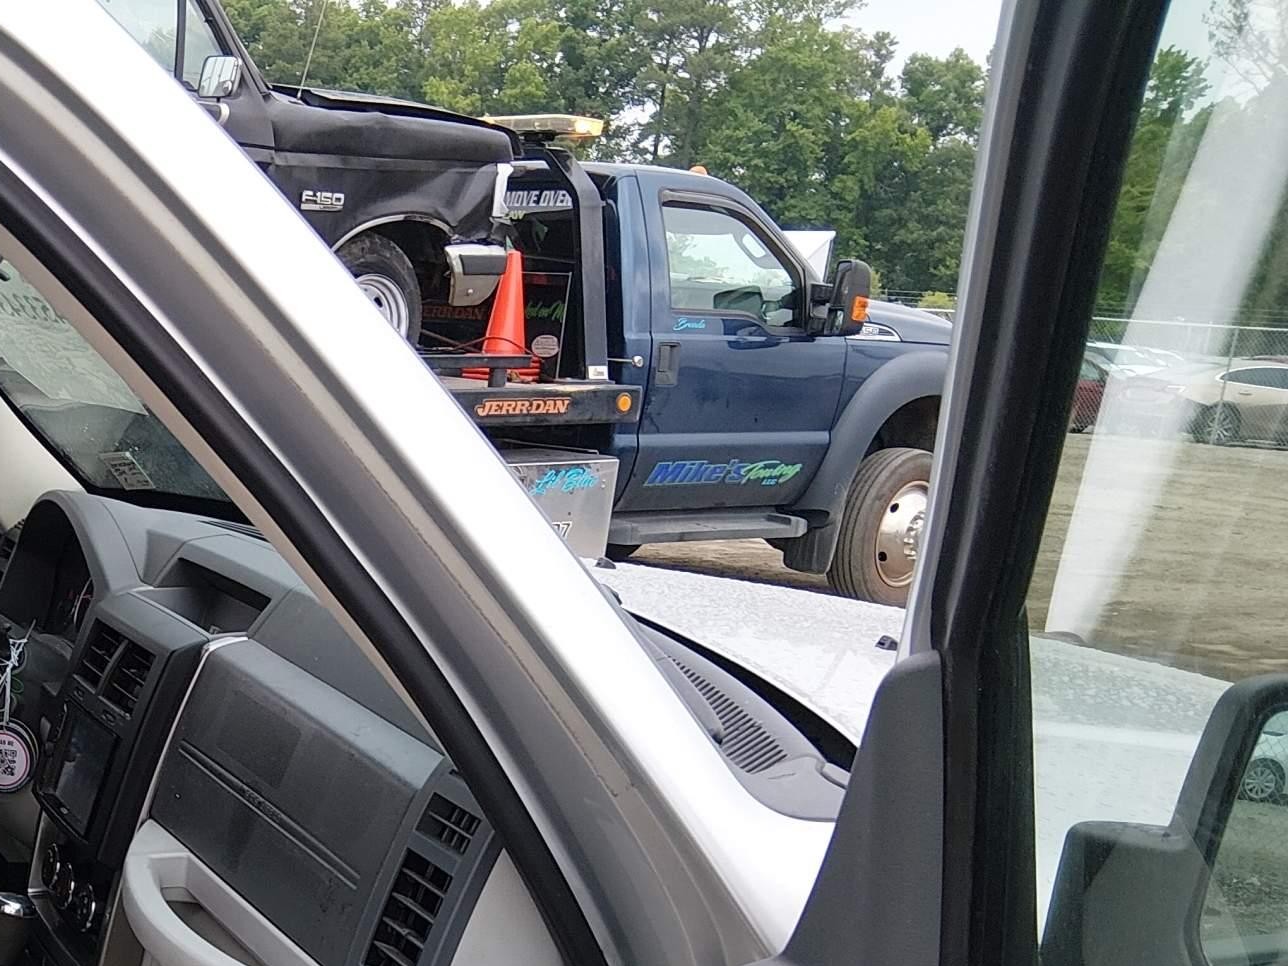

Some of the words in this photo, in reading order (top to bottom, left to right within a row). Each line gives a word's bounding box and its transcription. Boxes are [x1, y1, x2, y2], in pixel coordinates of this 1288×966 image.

[301, 189, 345, 206] F-150
[504, 190, 540, 207] MOVE
[643, 459, 751, 486] Mike's
[741, 460, 803, 484] Towing
